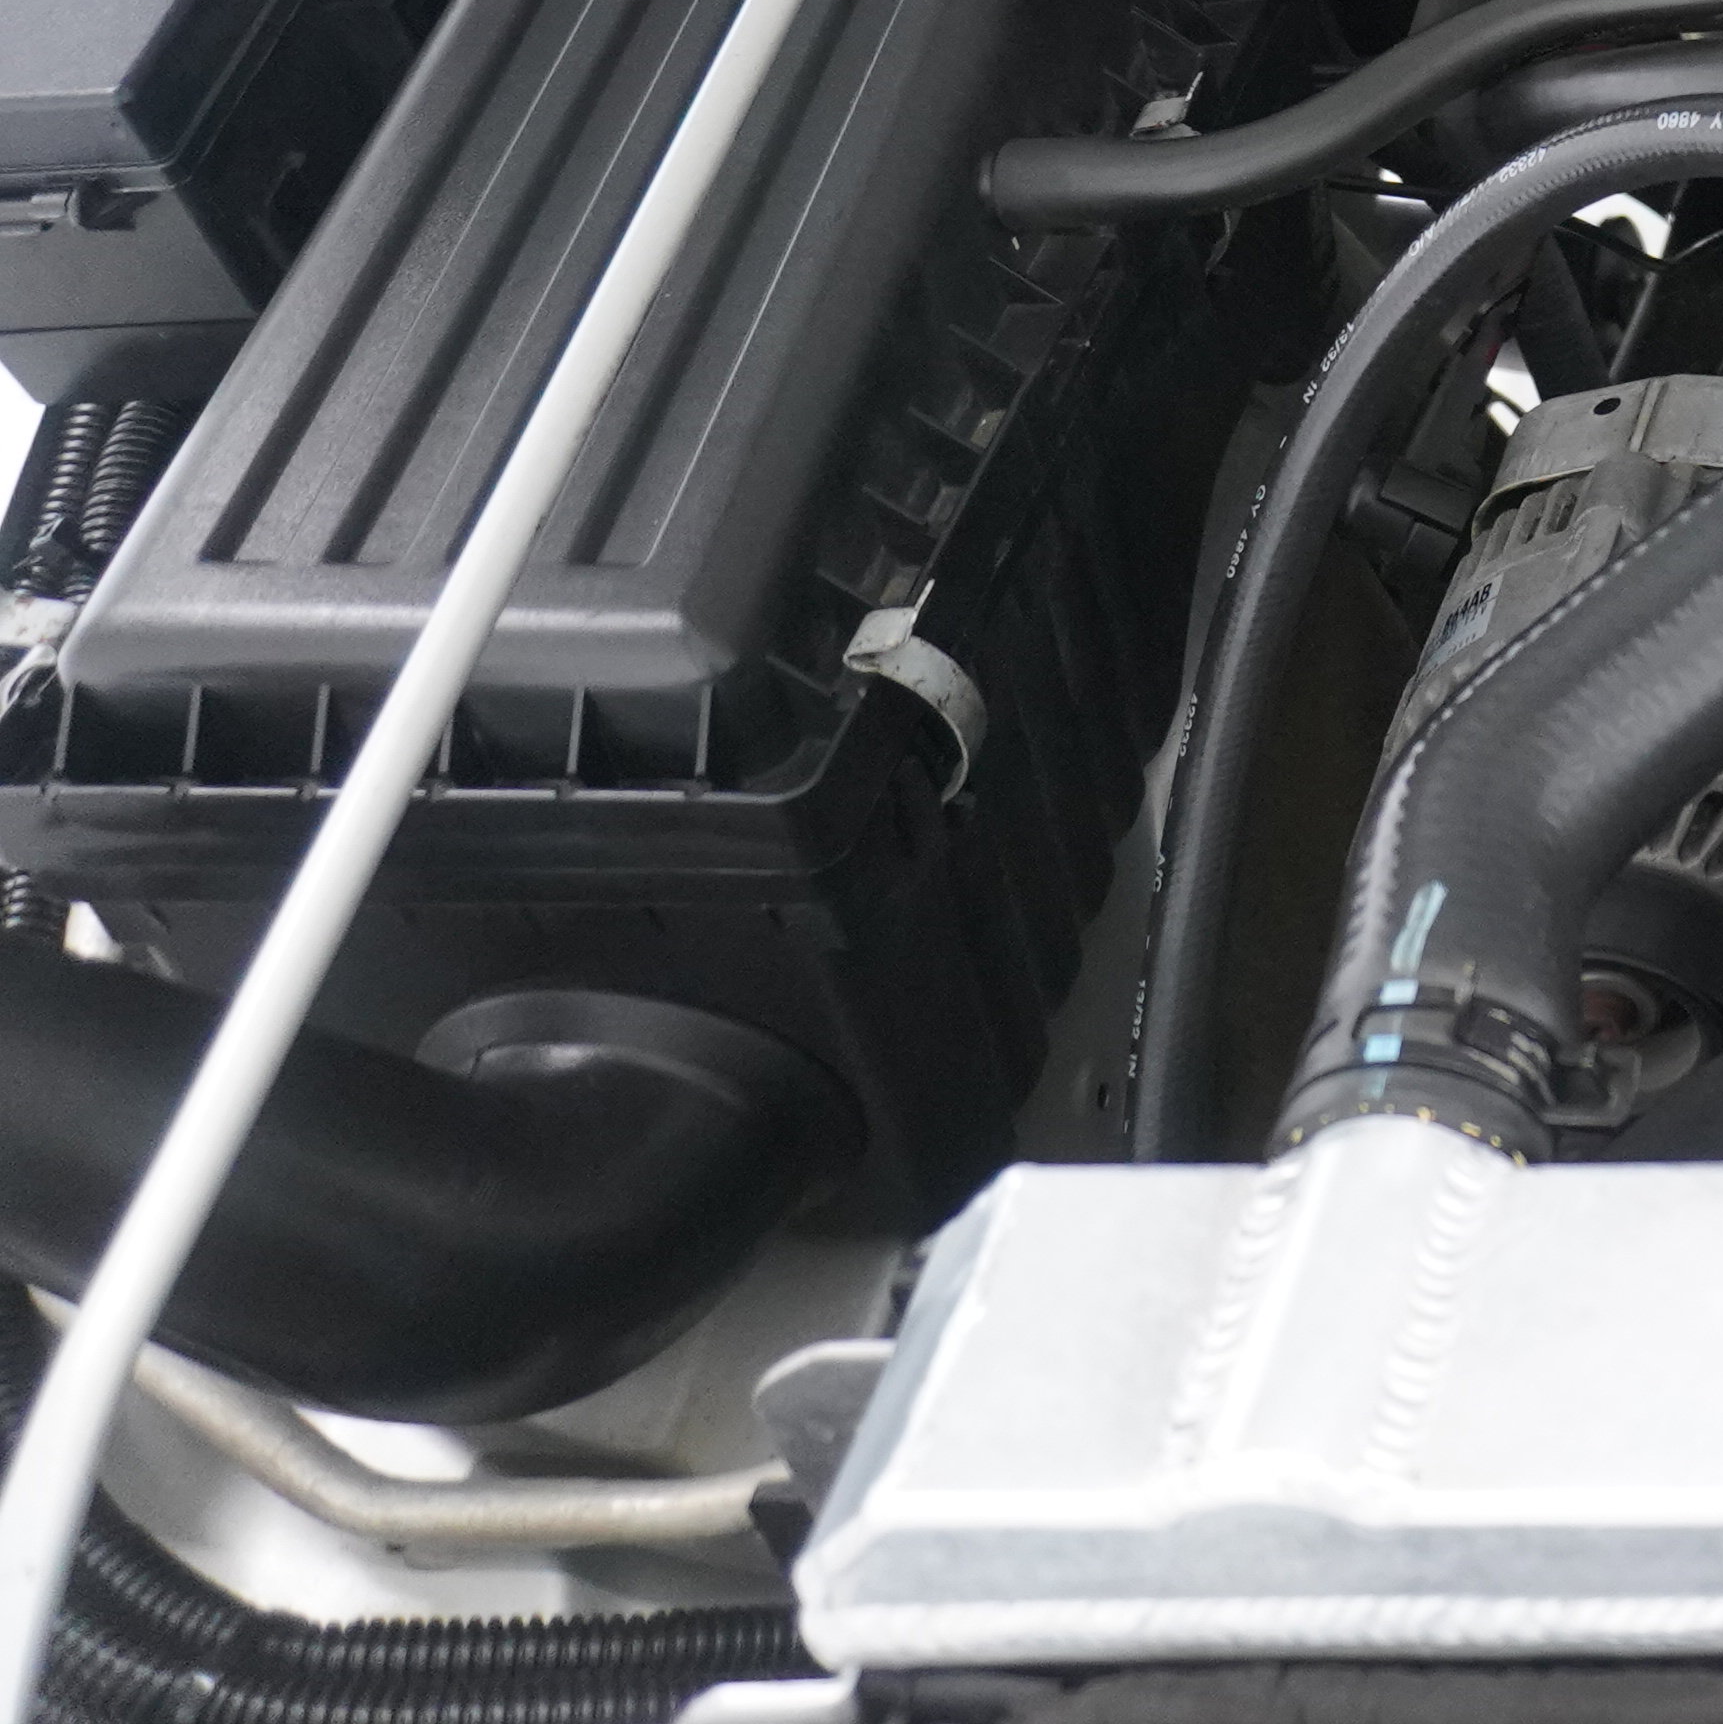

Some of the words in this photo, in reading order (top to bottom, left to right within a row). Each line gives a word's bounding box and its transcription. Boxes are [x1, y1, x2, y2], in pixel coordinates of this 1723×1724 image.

[1656, 111, 1701, 131] 4860
[1320, 322, 1355, 373] 13/32
[1303, 380, 1318, 405] IN
[1251, 483, 1266, 519] GY
[1226, 528, 1249, 579] 4860
[1179, 691, 1198, 758] 42332
